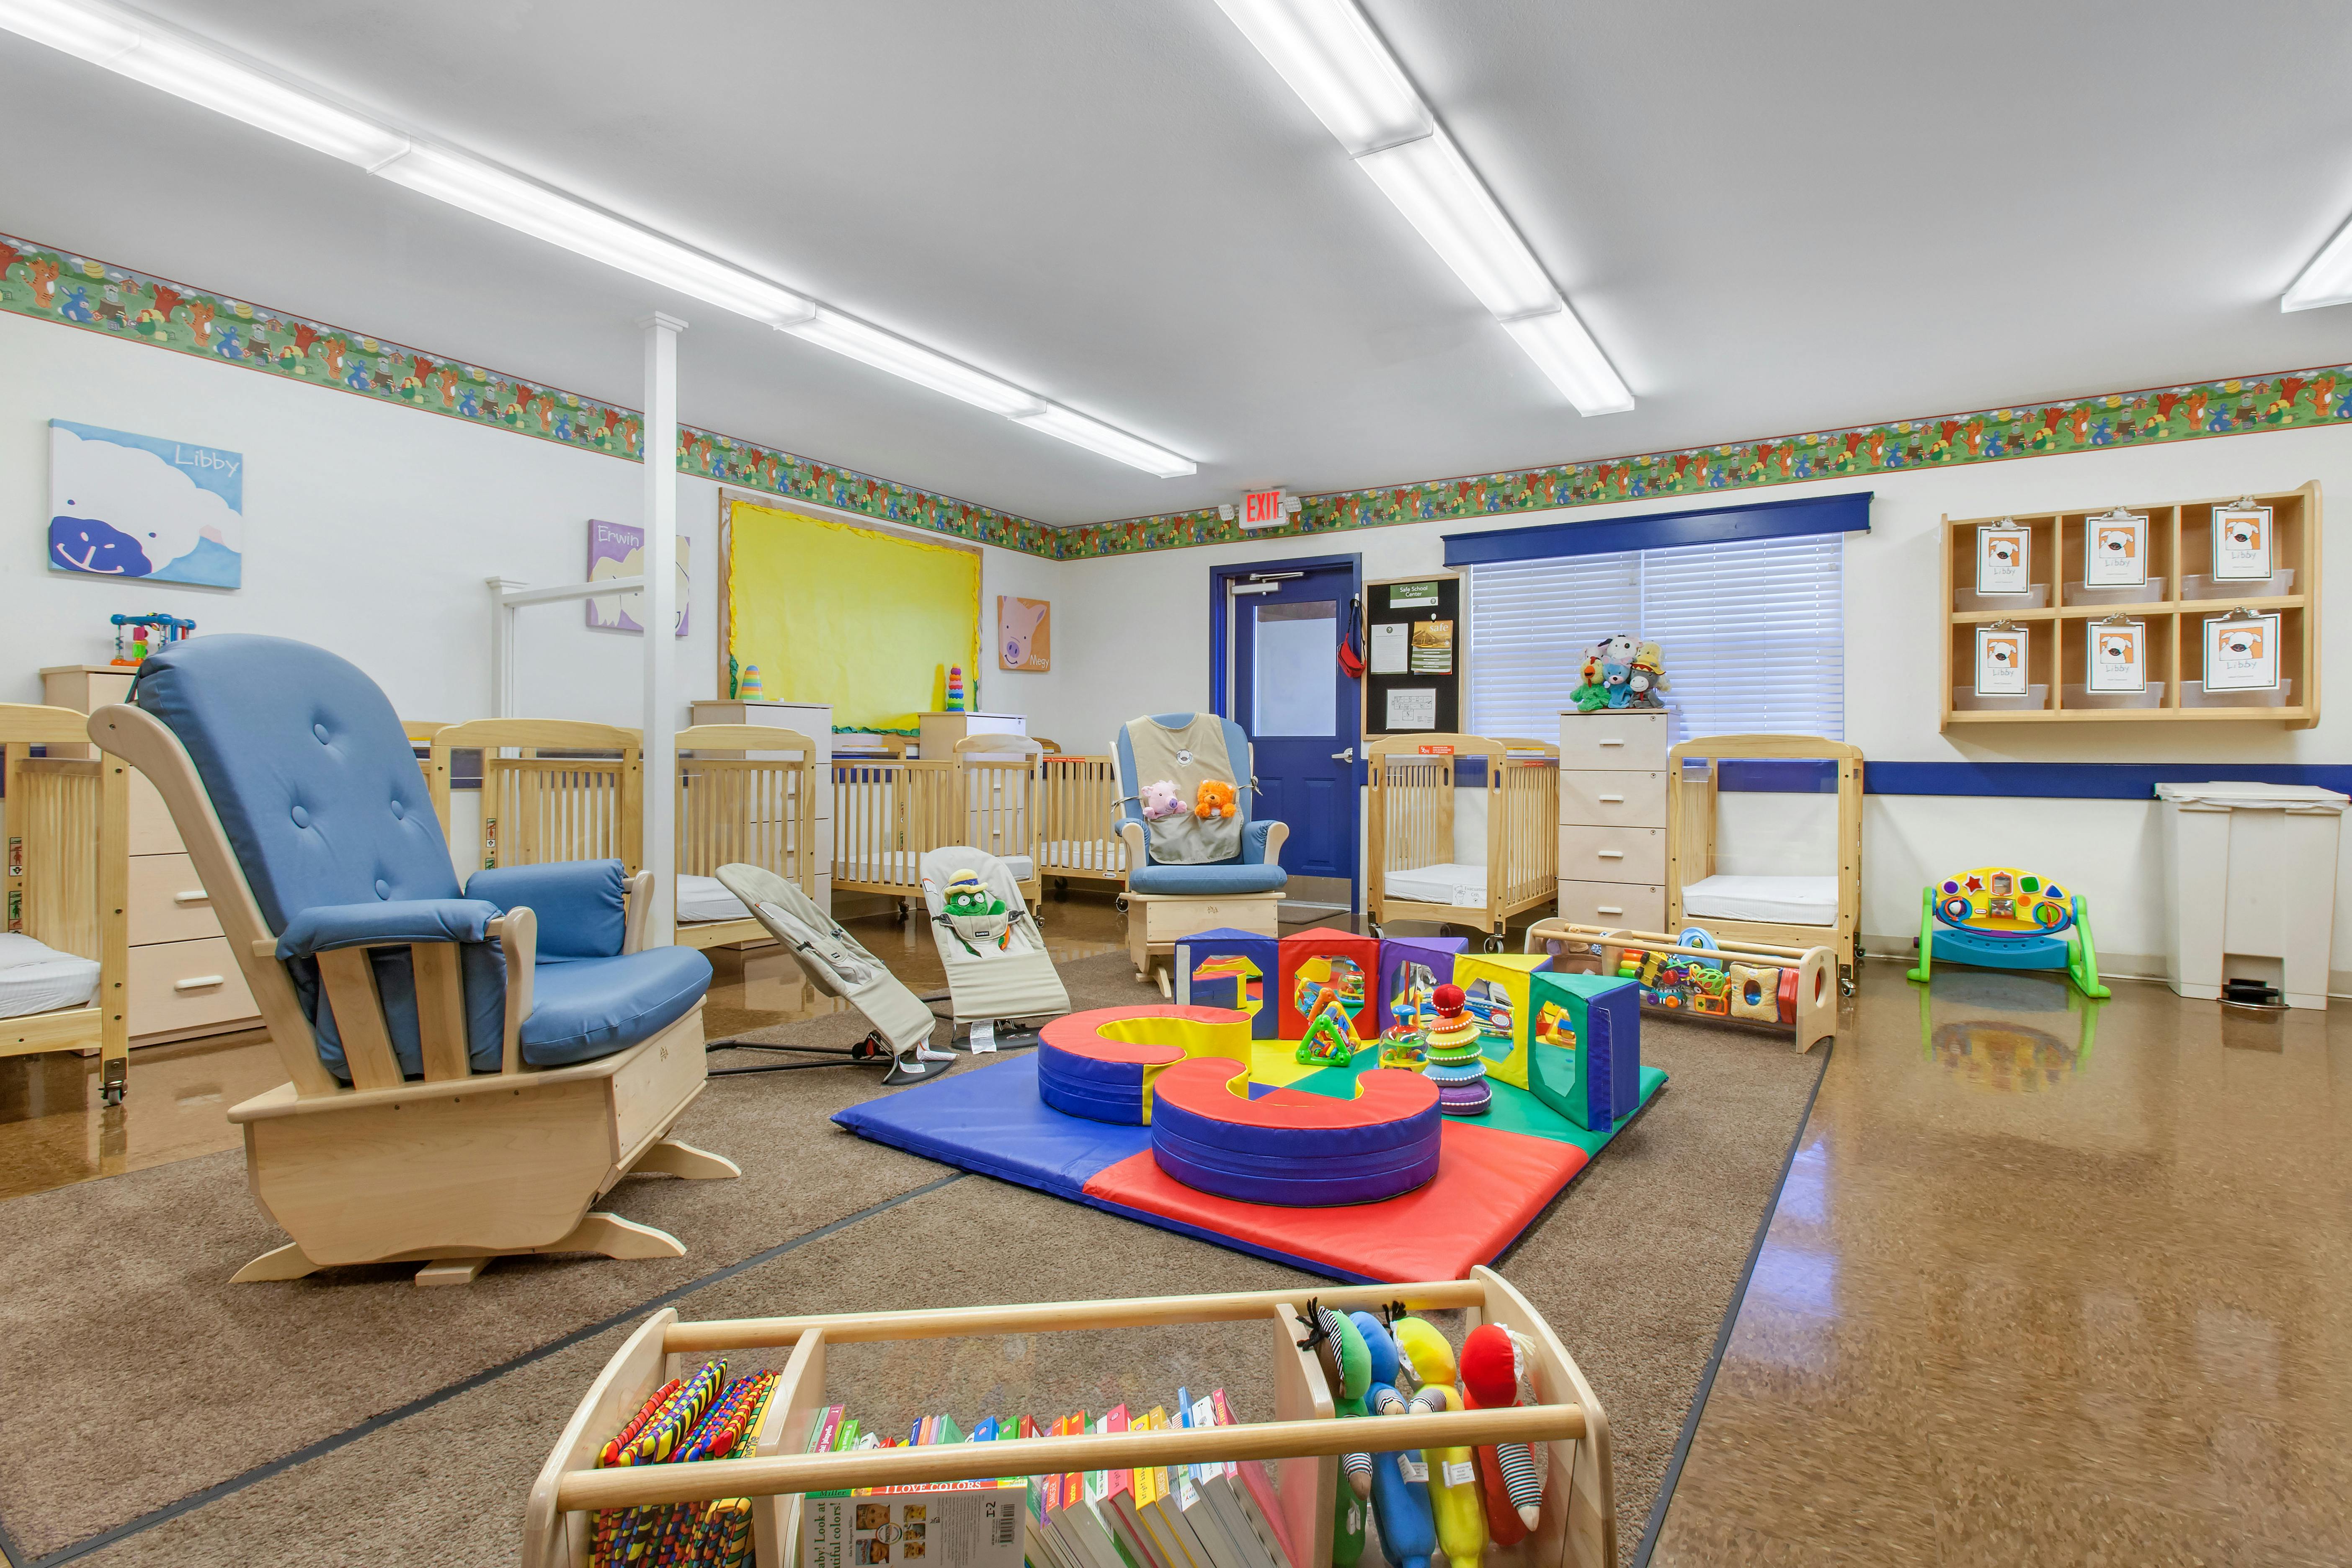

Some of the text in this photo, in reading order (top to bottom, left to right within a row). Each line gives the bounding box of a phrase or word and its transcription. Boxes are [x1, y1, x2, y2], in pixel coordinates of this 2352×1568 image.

[175, 445, 240, 477] Libby
[1246, 491, 1280, 522] EXIT
[598, 525, 639, 547] Erwin
[2105, 558, 2130, 567] Libby
[2231, 550, 2256, 560] Libby
[1994, 567, 2016, 576] Libby
[1429, 623, 1449, 632] safe
[1030, 654, 1050, 669] Megy
[2105, 665, 2129, 673] Libby
[2226, 660, 2257, 669] Libby
[1992, 669, 2014, 677] Libby
[1217, 1402, 1226, 1424] SWEETS
[818, 1444, 827, 1453] ola!
[885, 1481, 981, 1494] I LOVE COLORS
[1140, 1481, 1148, 1500] bright
[1157, 1470, 1166, 1496] SANGER
[1048, 1481, 1057, 1507] SANGER
[830, 1502, 841, 1539] colors!
[814, 1502, 829, 1568] aby! Look at
